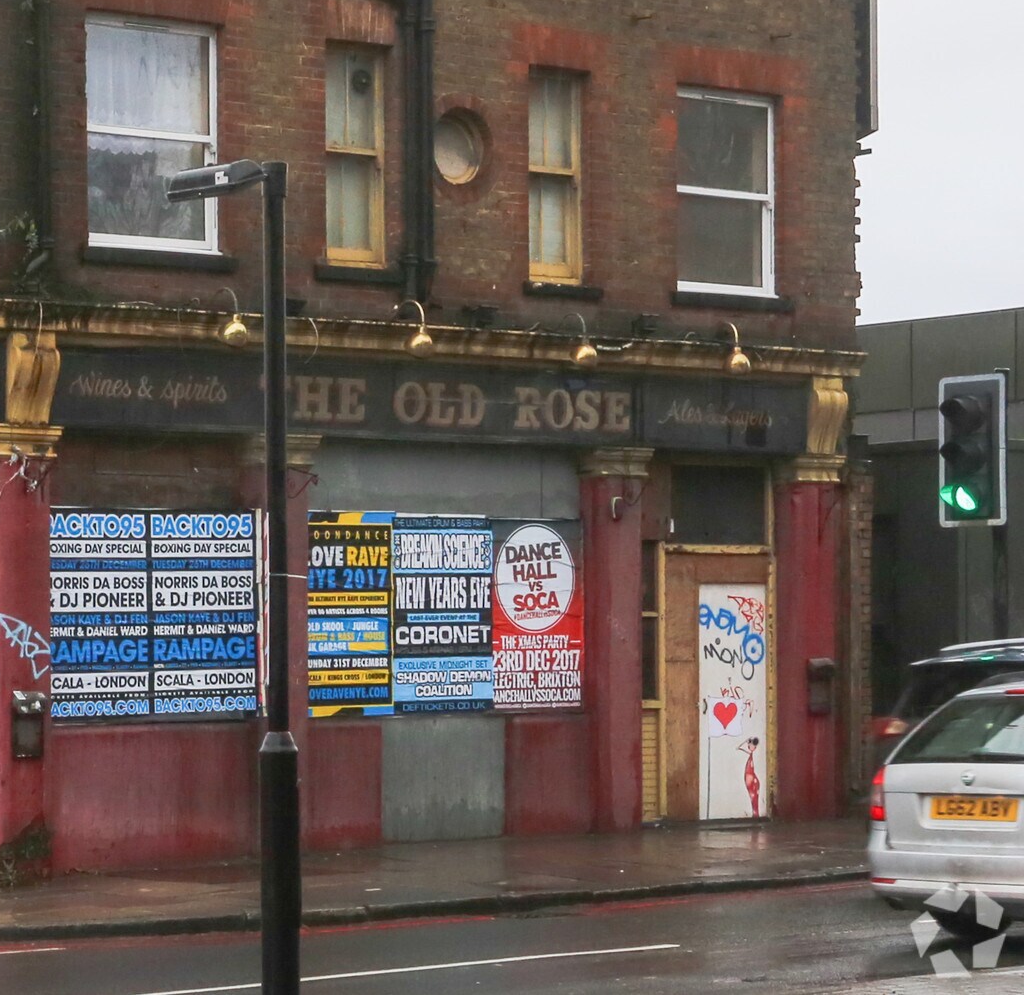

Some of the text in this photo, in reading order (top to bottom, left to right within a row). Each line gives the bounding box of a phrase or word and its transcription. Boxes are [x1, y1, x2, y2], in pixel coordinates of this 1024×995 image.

[70, 372, 228, 409] Wines & spirits
[260, 375, 631, 433] HE OLD ROSE
[150, 513, 253, 539] BACKTO95
[433, 519, 450, 527] DRUM
[457, 519, 472, 527] BASS
[85, 544, 103, 554] DAY
[106, 544, 144, 554] SPECIAL
[154, 543, 251, 554] BOXING DAY SPECIAL
[443, 534, 485, 570] SCIENCE
[505, 541, 562, 564] DANCE
[308, 546, 388, 567] OVE RAVE
[103, 560, 147, 570] DECEMBER
[152, 560, 187, 570] TUESDAY
[190, 560, 209, 569] 26TH
[513, 561, 557, 583] HALL
[50, 577, 145, 589] ORRIS DA BOSS
[155, 576, 252, 589] NORRIS DA BOSS
[343, 569, 388, 589] 2017
[528, 581, 543, 592] VS
[60, 593, 144, 607] DJ PIONEER
[155, 591, 252, 606] & DJ PIONEER
[396, 576, 491, 610] NEW YEARS EVE
[513, 591, 559, 612] SOCA
[79, 615, 101, 624] KAYE
[104, 615, 111, 624] &
[114, 615, 127, 624] DJ
[154, 614, 186, 623] JASON
[188, 613, 210, 623] KAYE
[213, 613, 220, 622] &
[222, 613, 235, 622] DJ
[77, 626, 84, 636] &
[86, 626, 118, 636] DANIEL
[120, 626, 148, 636] WARD
[154, 623, 255, 635] HERMIT & DANIEL WARD
[322, 621, 378, 631] SKOOL JUNGLE
[395, 625, 491, 644] CORONET
[501, 635, 517, 650] THE
[518, 635, 543, 650] XMAS
[543, 634, 569, 649] PARTY
[153, 637, 255, 662] RAMPAGE
[333, 659, 350, 668] 31ST
[352, 658, 388, 667] DECEMBER
[398, 659, 488, 670] EXCLUSIVE MIDNIGHT SET
[526, 649, 551, 671] DEC
[551, 649, 581, 671] 2017
[95, 675, 146, 689] LONDON
[156, 671, 255, 687] SCALA LONDON
[396, 670, 491, 685] SHADOW DEMON
[538, 671, 581, 688] BRIXTON
[415, 684, 473, 698] COALITION
[154, 695, 257, 714] BACKTO95.COM
